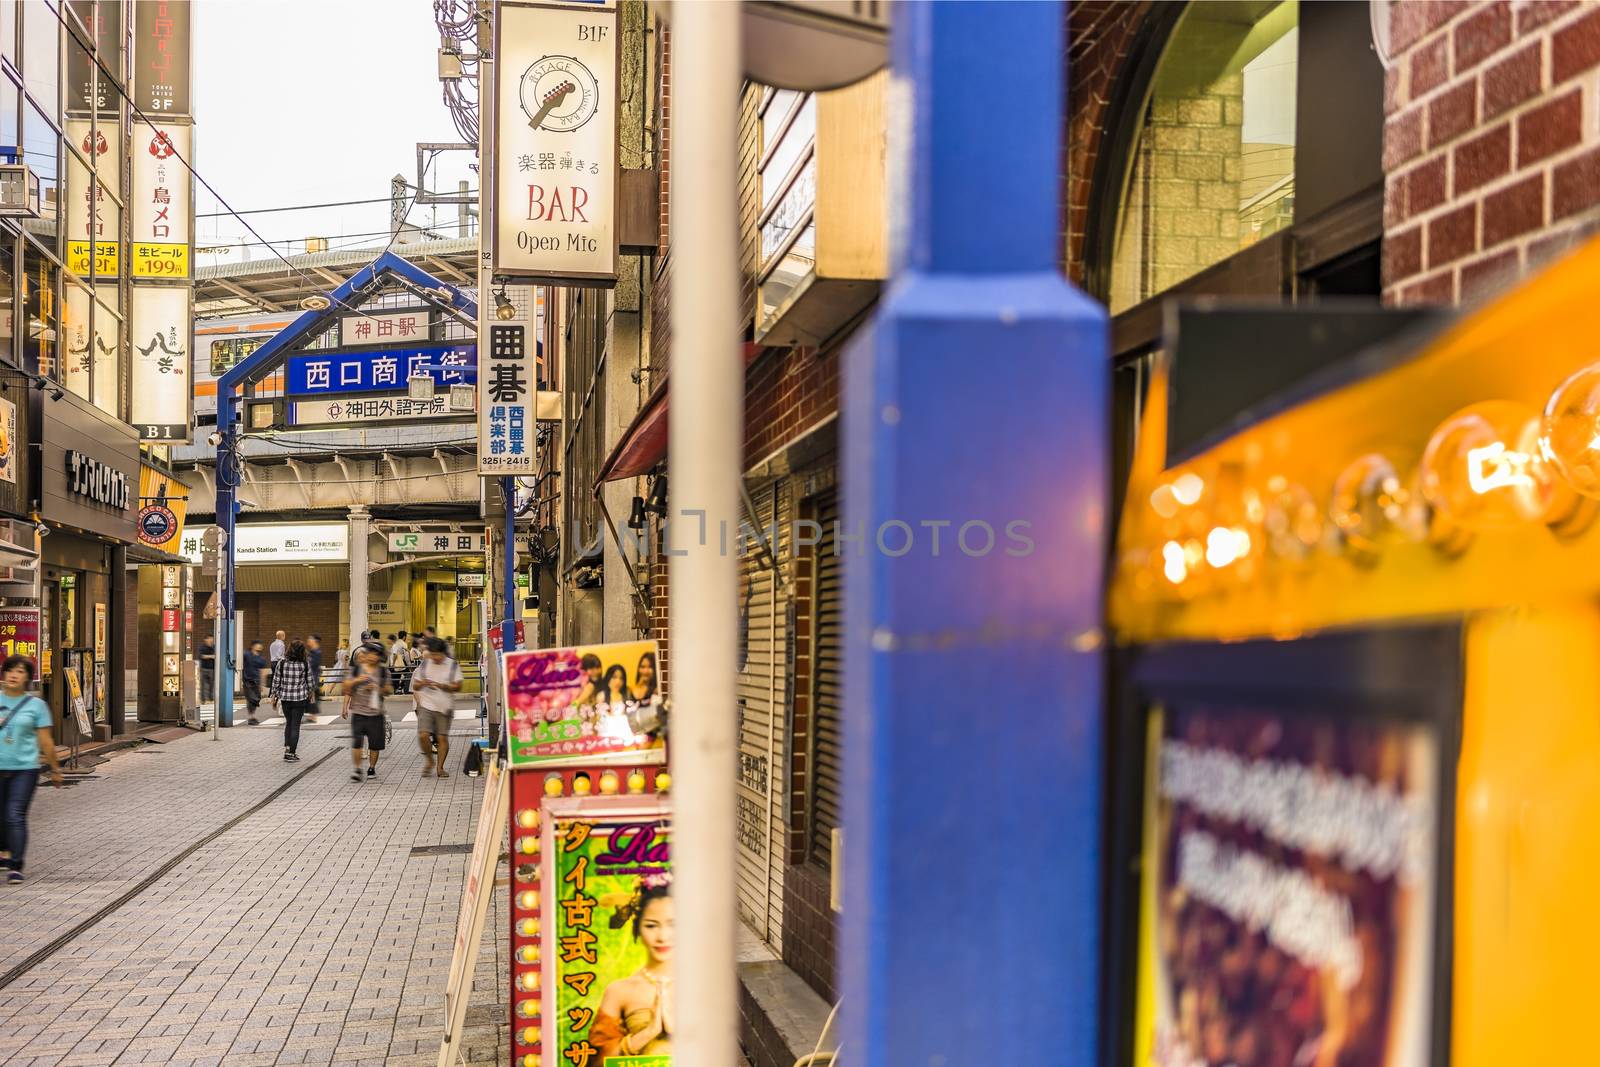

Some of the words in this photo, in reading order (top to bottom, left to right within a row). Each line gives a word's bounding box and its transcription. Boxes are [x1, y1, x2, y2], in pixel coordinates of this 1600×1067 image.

[578, 24, 609, 42] B1F
[151, 98, 174, 110] 3F
[152, 186, 171, 238] 鳥メロ
[526, 184, 590, 223] BAR
[139, 247, 183, 258] 生ビール
[517, 231, 560, 254] Open
[566, 232, 598, 253] Mic
[355, 317, 416, 339] 神田駅
[305, 351, 468, 389] 西口商店街
[488, 325, 527, 403] 囲碁
[346, 397, 445, 419] 神田外語学院
[146, 425, 172, 439] B1
[508, 406, 525, 454] 西口囲碁
[482, 457, 530, 465] 3251-2415
[71, 449, 130, 511] サンマルクカフェ
[285, 539, 300, 548] 西口
[396, 534, 418, 547] JR
[560, 821, 599, 1067] タイ古式マッサ
